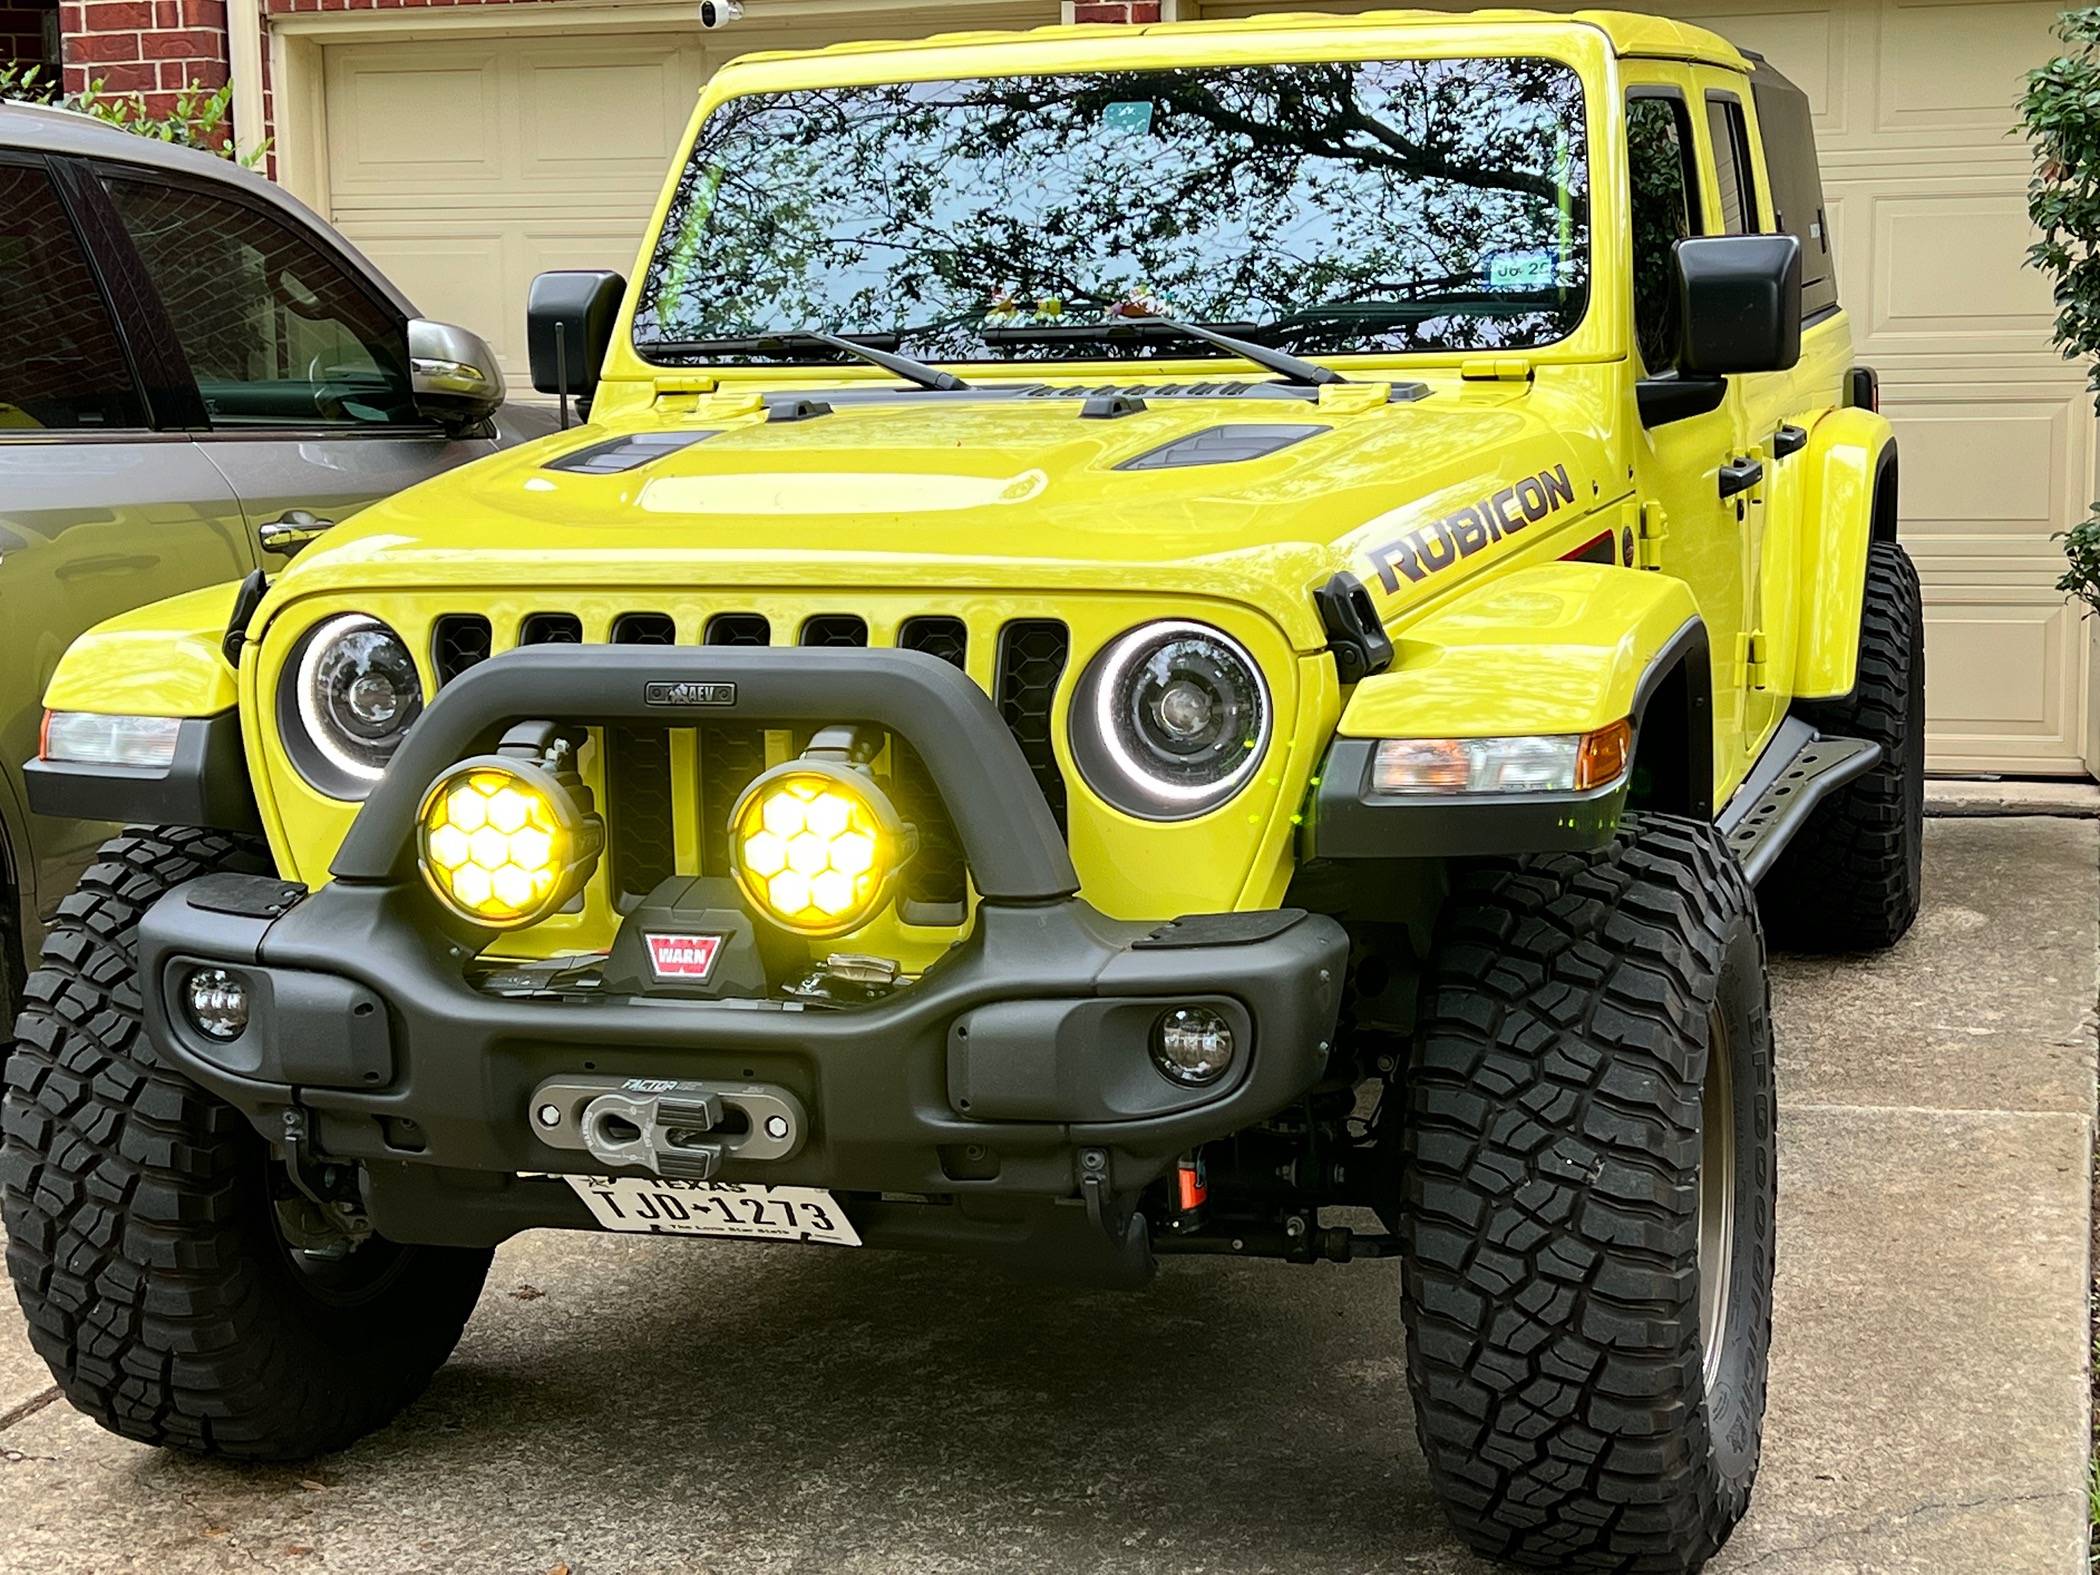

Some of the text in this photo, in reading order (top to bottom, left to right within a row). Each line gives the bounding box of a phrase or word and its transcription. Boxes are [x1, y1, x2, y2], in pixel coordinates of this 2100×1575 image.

[1367, 463, 1576, 596] RUBICON
[688, 686, 715, 701] AEV
[658, 947, 706, 964] WARN
[621, 1078, 679, 1092] FACTOR
